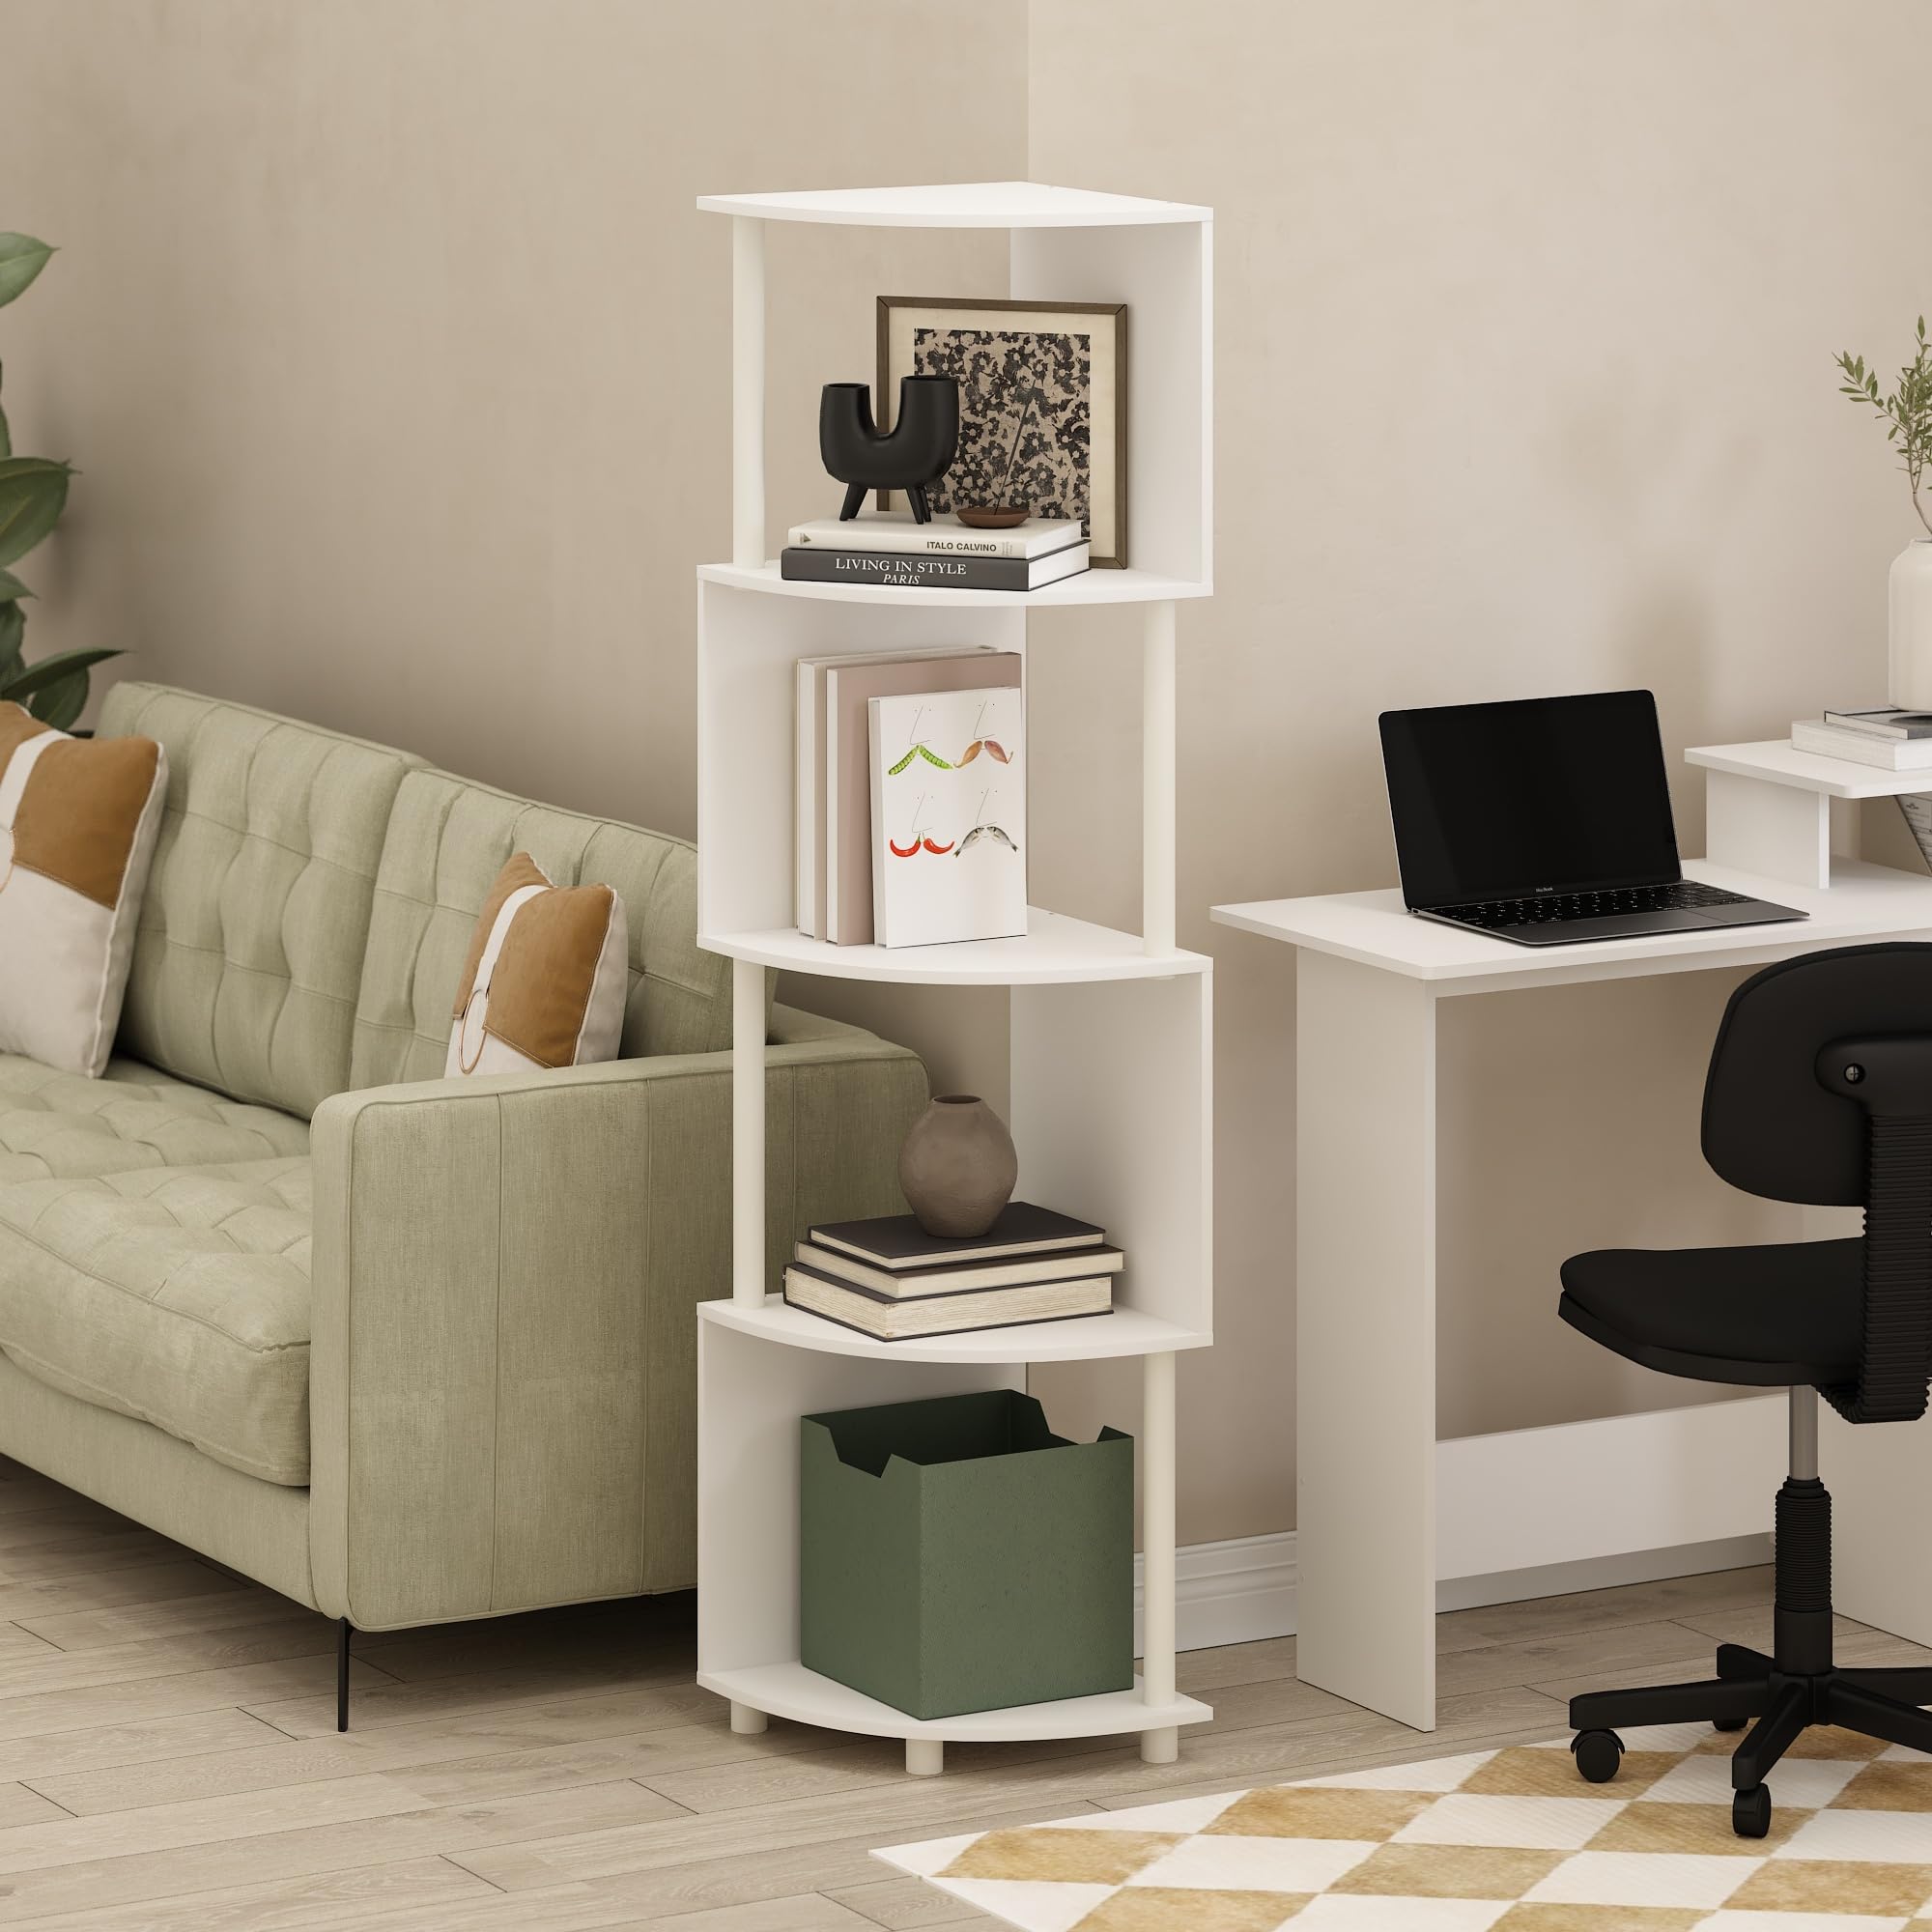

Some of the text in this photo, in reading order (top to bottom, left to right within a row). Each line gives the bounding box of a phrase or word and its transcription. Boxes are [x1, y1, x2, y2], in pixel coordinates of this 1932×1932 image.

[926, 541, 953, 551] ITALO
[956, 542, 997, 553] CALVINO
[835, 557, 967, 575] LIVING IN STYLE
[883, 574, 921, 585] PARIS
